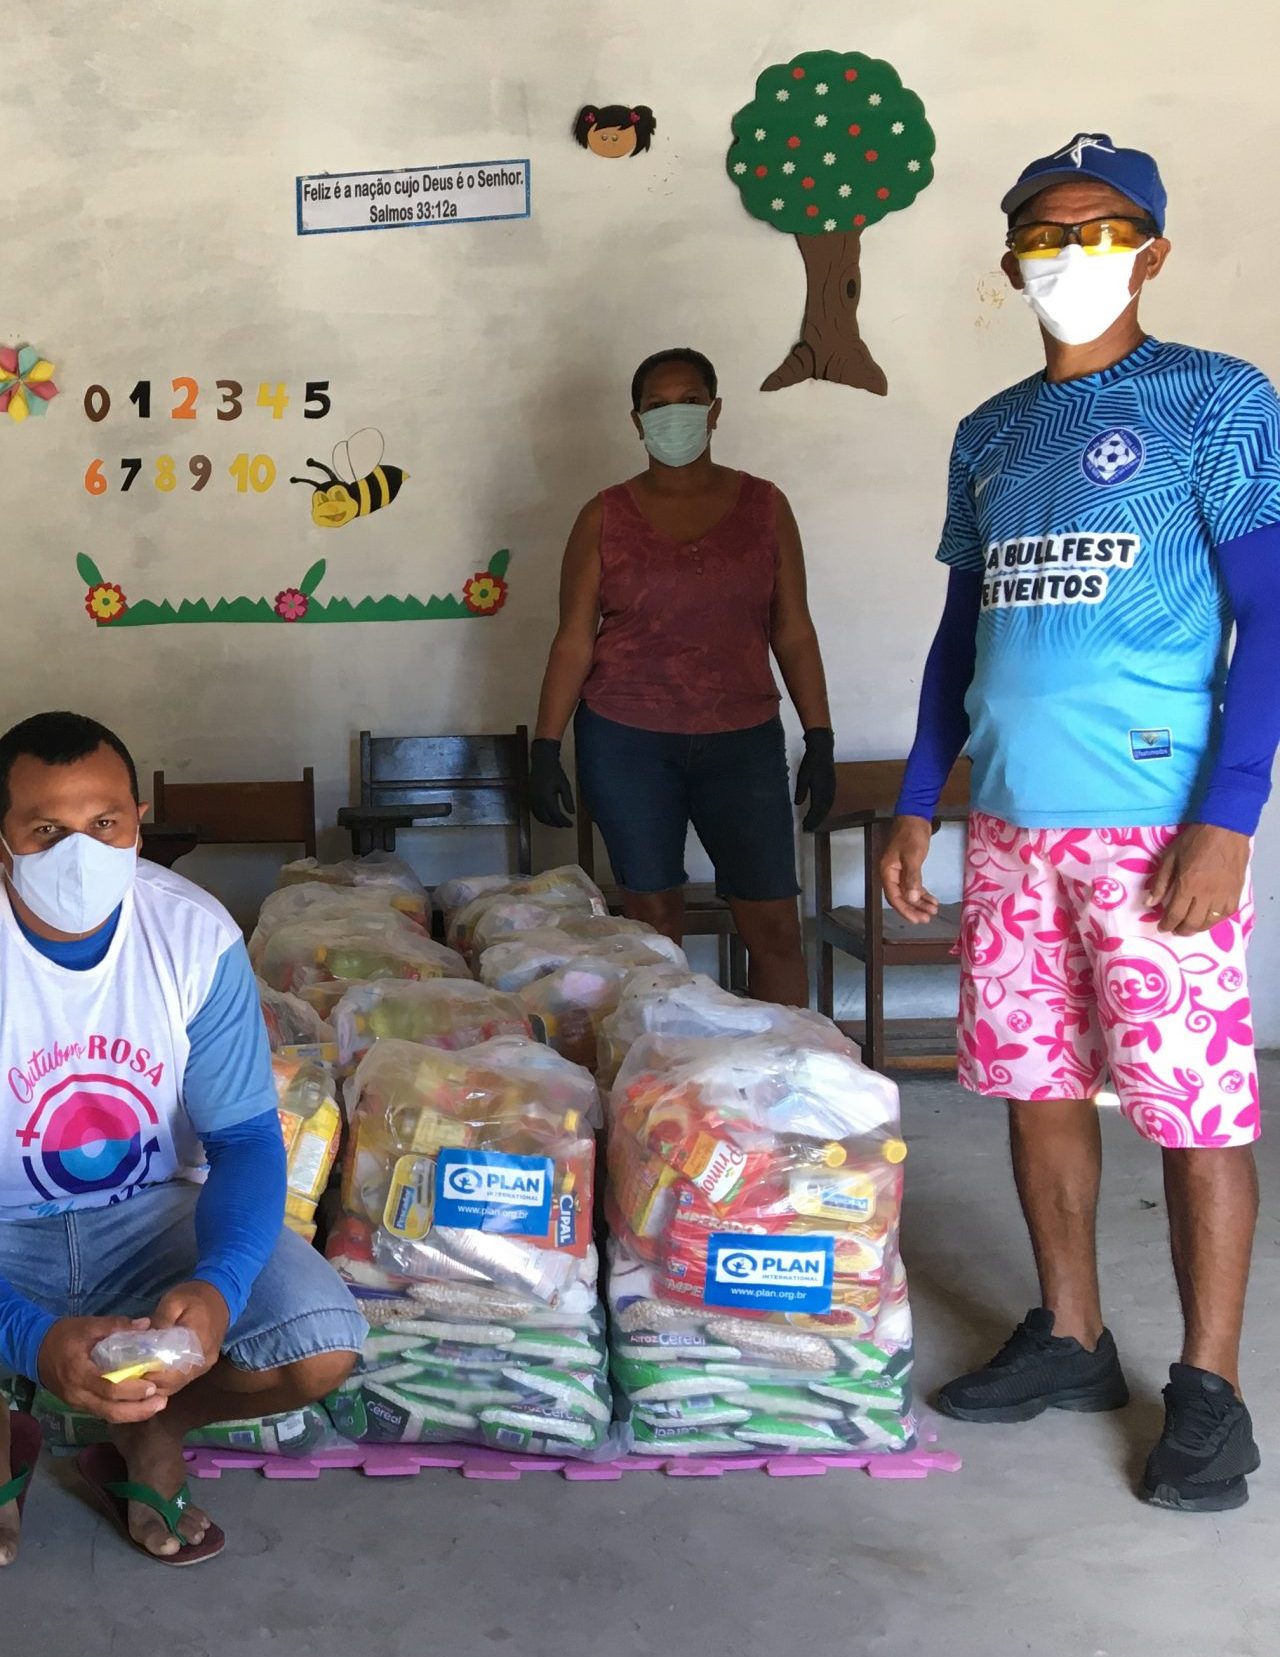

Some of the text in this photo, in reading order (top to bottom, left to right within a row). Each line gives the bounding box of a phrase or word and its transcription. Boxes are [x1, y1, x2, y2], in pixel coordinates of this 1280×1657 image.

[304, 168, 524, 201] Feliz é a nação cujo Deus é o Senhor.
[370, 200, 457, 223] Salmos 33:12a
[129, 380, 150, 418] 1
[171, 377, 199, 419] 2
[215, 380, 243, 421] 3
[257, 383, 289, 419] 4
[304, 381, 331, 419] 5
[84, 454, 276, 496] 6 7 8 9 10
[992, 575, 1103, 604] EVENTOS
[88, 1034, 164, 1087] ROSA
[487, 1173, 540, 1193] PLAN
[701, 1142, 745, 1198] Primor
[559, 1194, 574, 1243] CIPAL
[762, 1257, 819, 1273] PLAN
[731, 1287, 807, 1300] www.plan.org.br
[366, 1402, 402, 1425] Cereal
